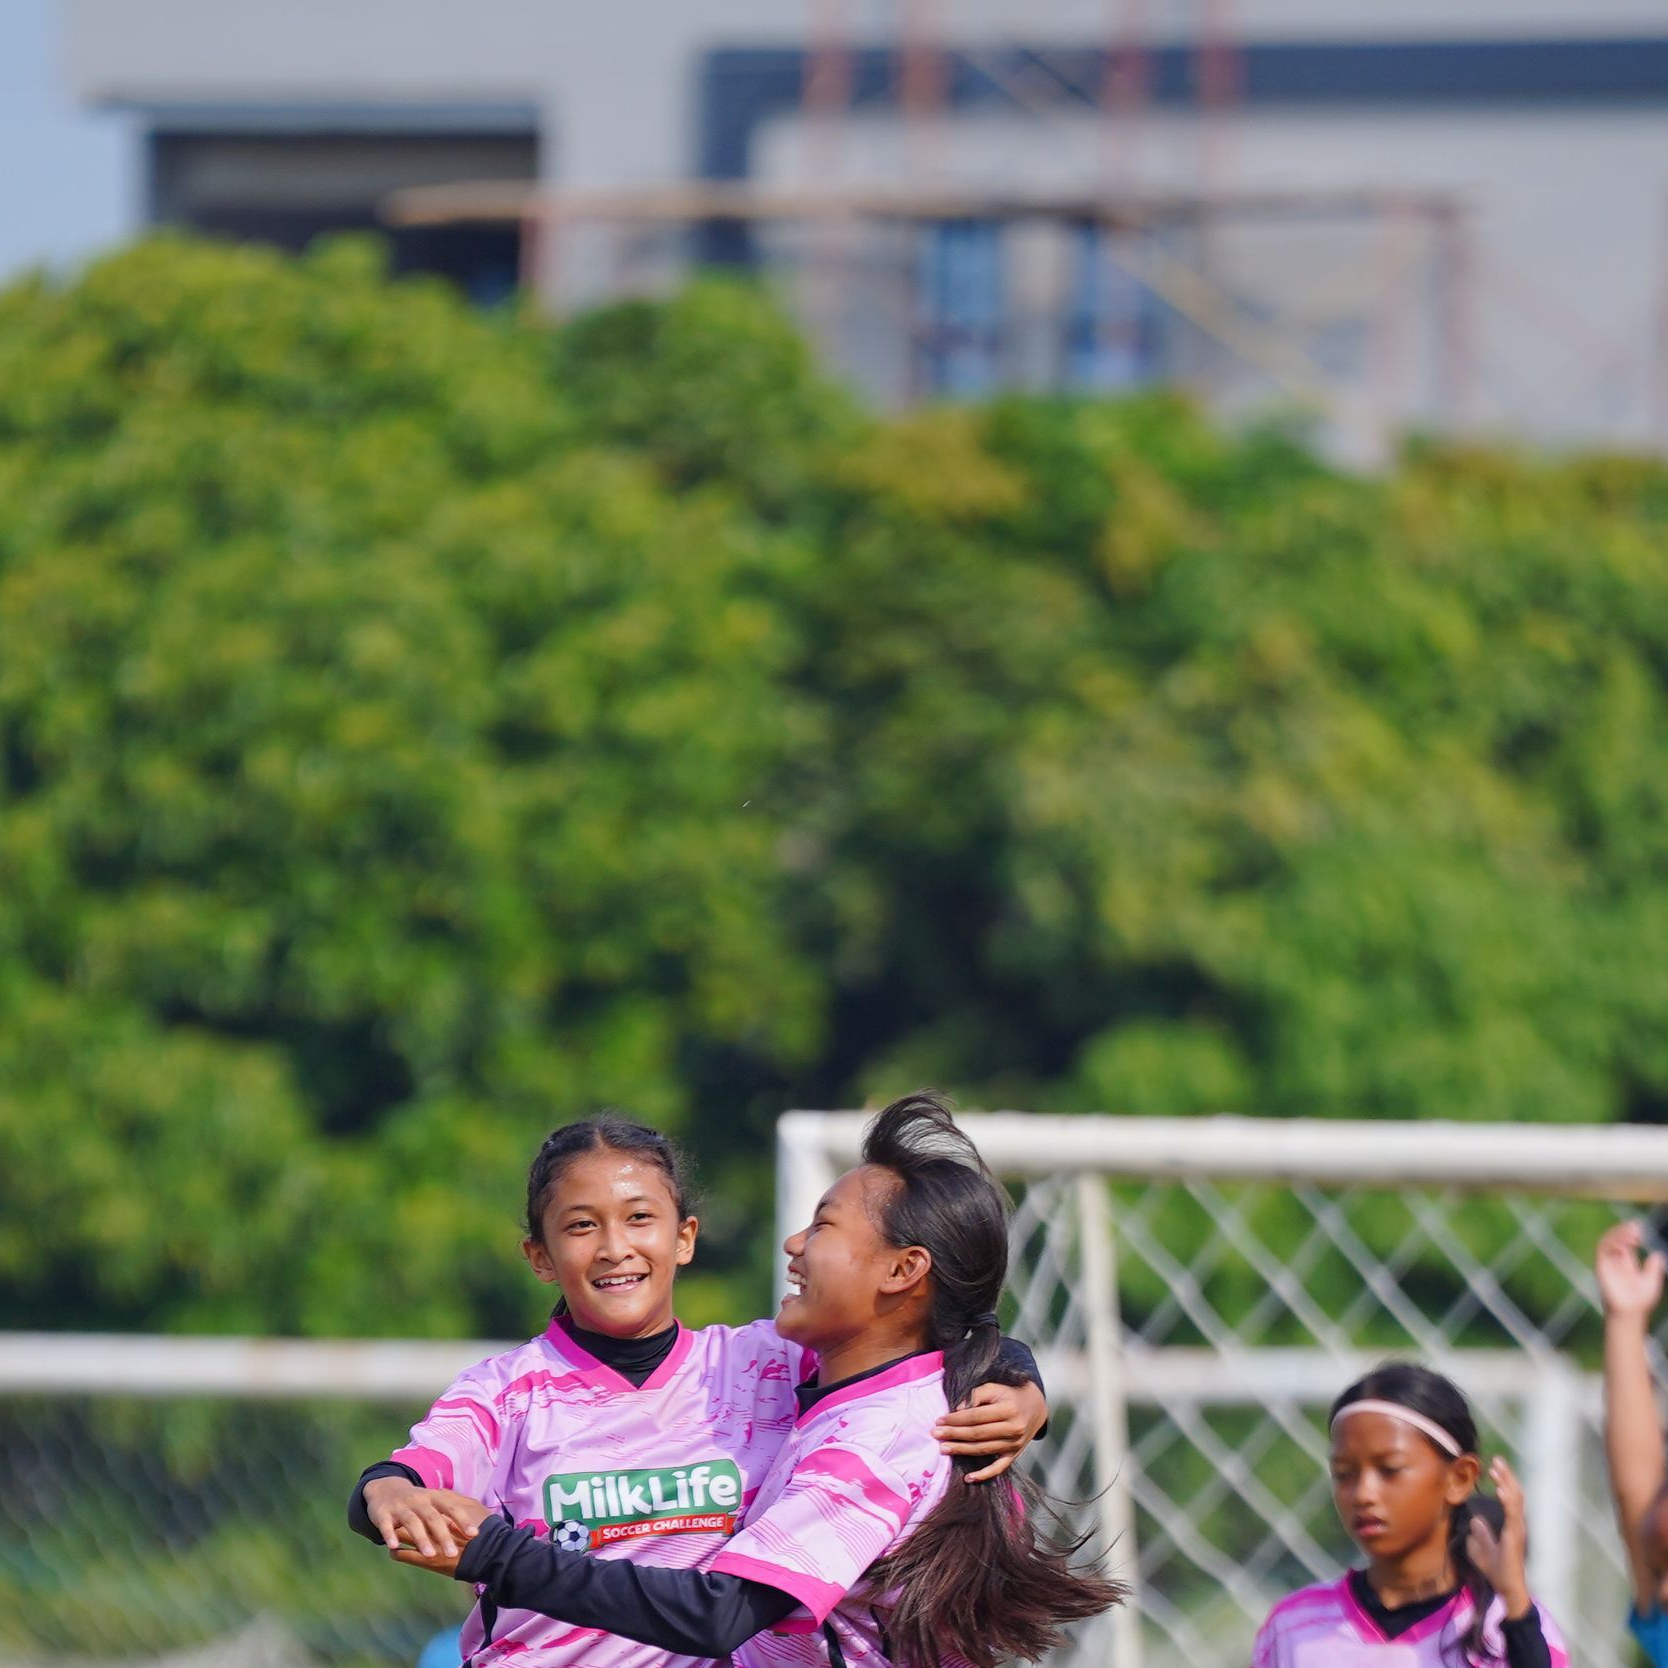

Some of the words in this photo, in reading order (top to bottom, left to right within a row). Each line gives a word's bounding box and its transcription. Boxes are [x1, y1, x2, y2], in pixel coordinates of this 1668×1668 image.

[549, 1466, 738, 1523] MilkLife
[603, 1521, 650, 1540] SOCCER
[653, 1516, 725, 1533] CHALLENGE
